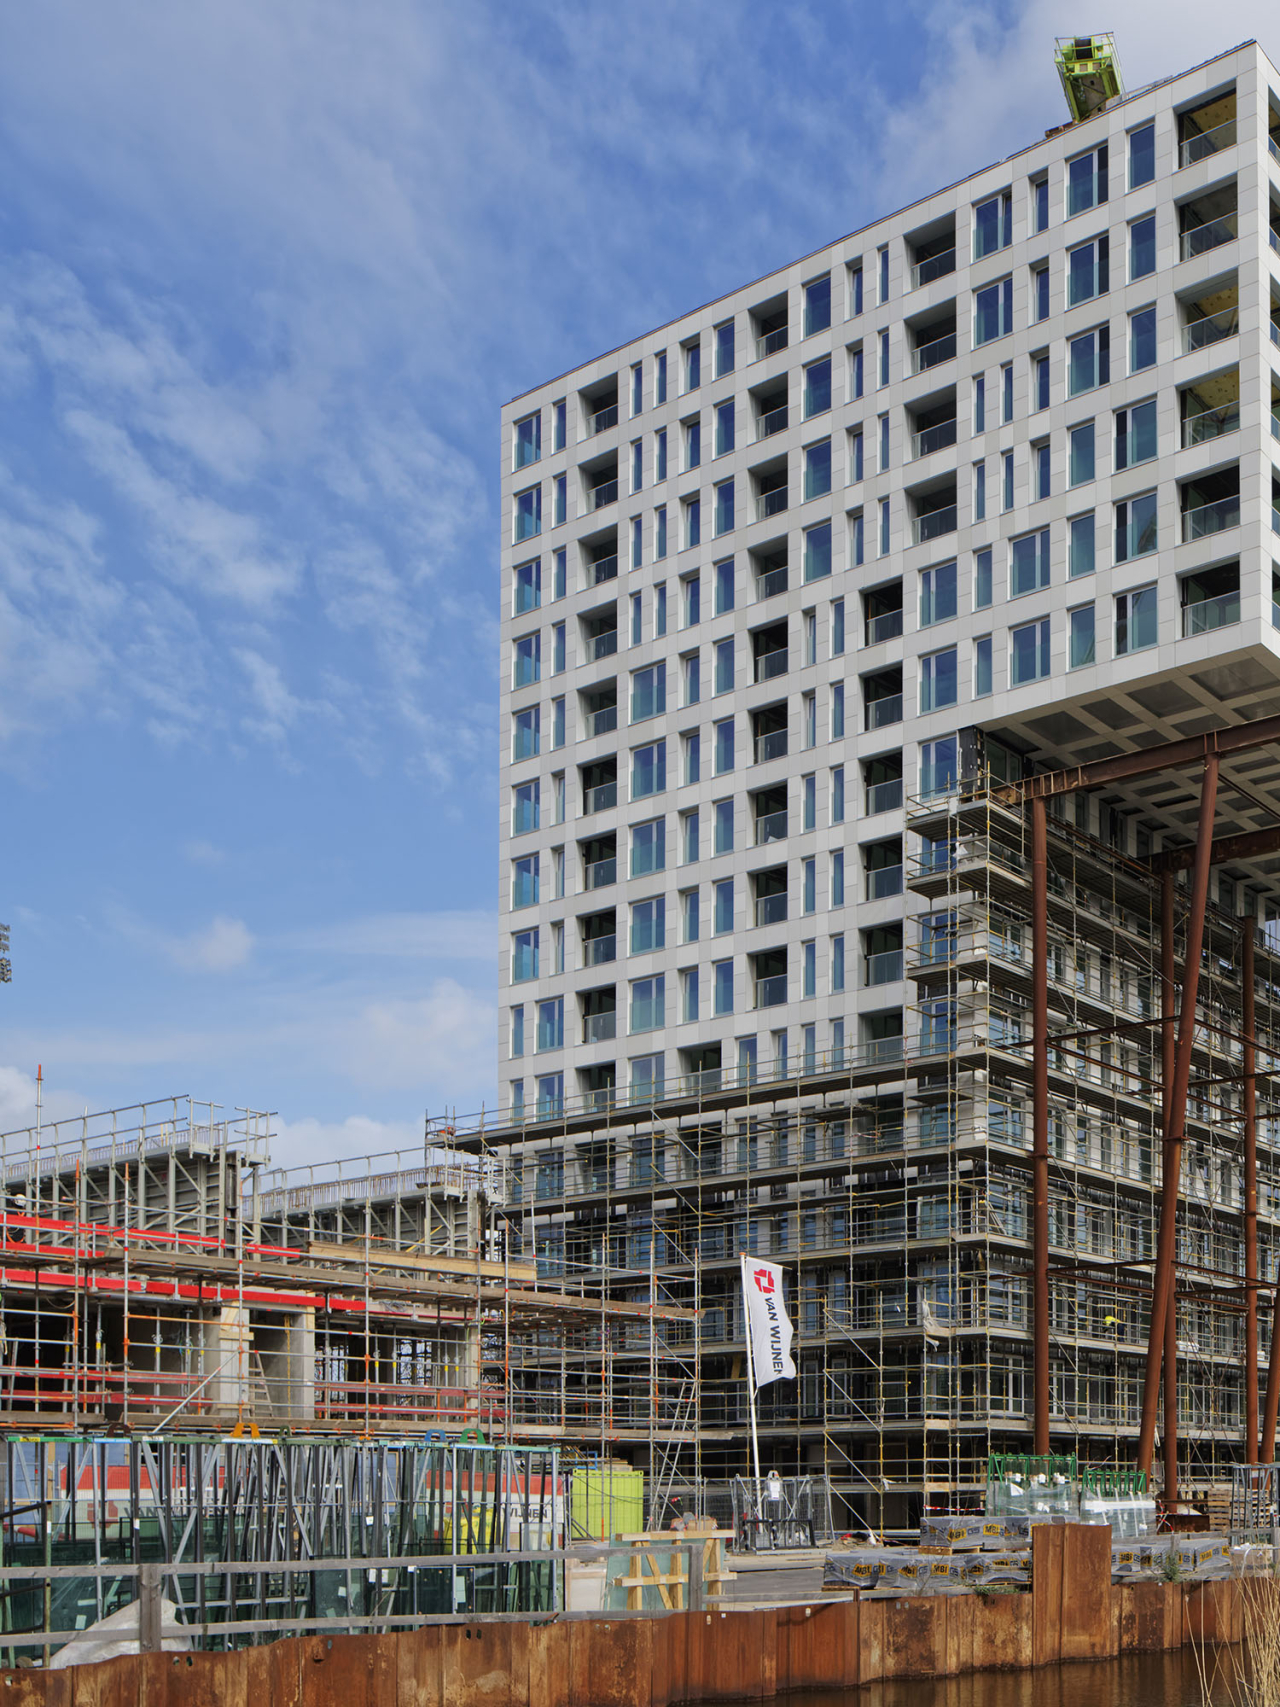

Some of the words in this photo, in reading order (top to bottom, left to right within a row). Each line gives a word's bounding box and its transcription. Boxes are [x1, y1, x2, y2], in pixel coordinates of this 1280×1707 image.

[765, 1297, 778, 1321] VAN
[770, 1325, 783, 1375] WIJNEN
[933, 1565, 948, 1574] MBI
